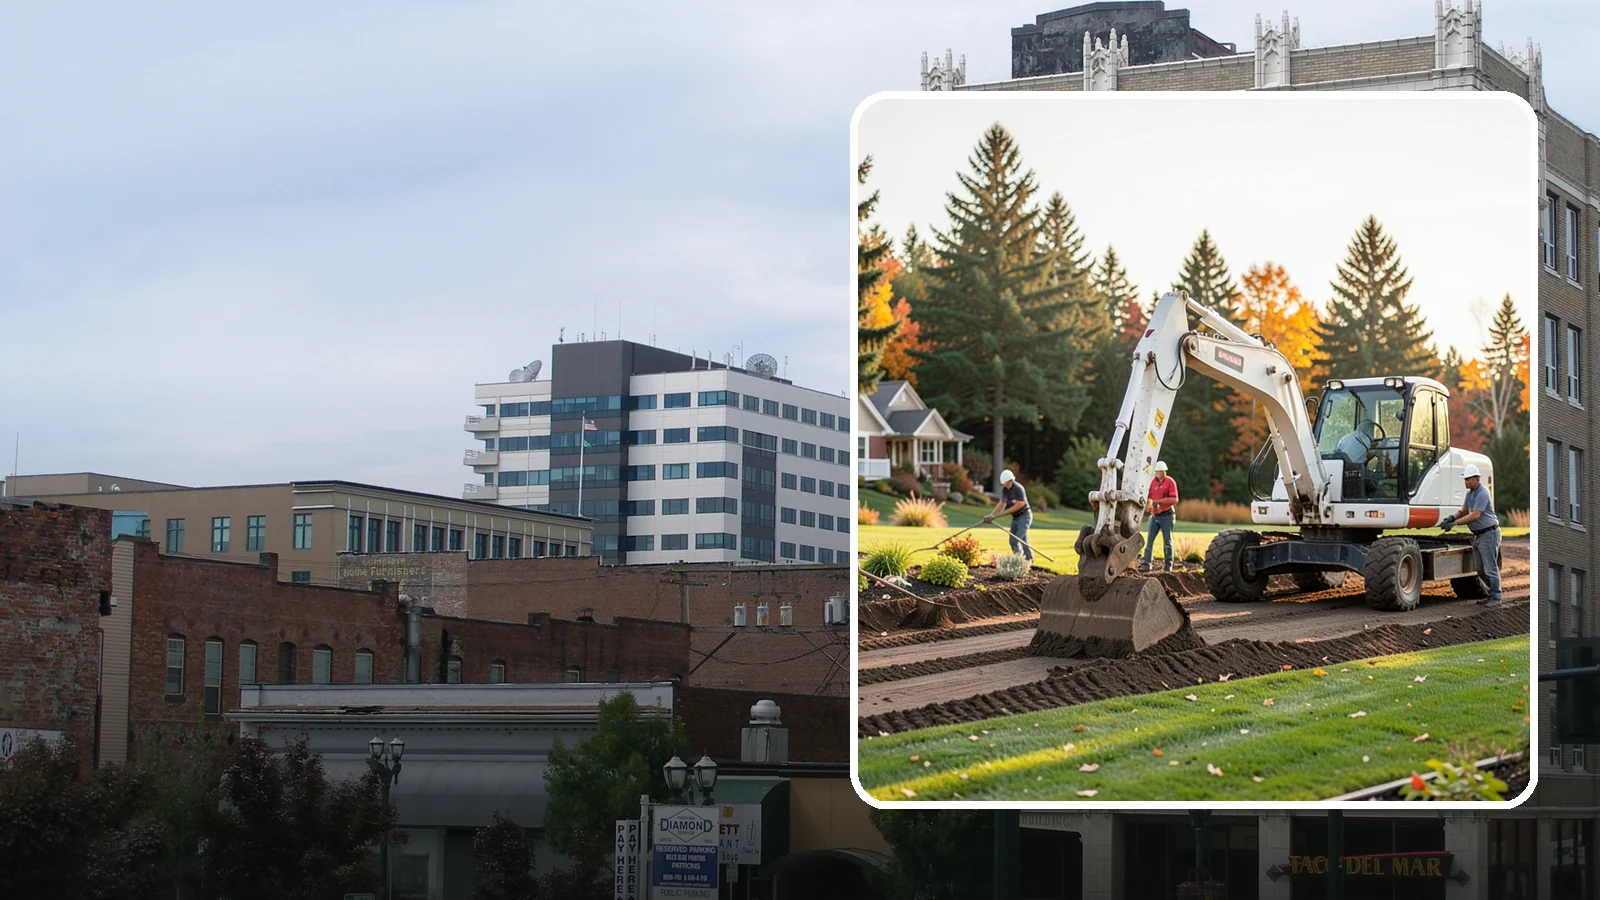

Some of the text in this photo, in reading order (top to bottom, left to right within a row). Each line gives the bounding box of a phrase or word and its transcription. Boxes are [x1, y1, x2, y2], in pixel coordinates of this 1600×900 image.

[370, 565, 427, 576] Furnishers
[660, 818, 713, 832] DIAMOND
[1022, 815, 1070, 828] BUILDING
[655, 845, 716, 854] RESERVED PARKING
[616, 825, 625, 893] PAY HERE
[627, 824, 636, 893] PAY HERE
[721, 851, 739, 862] Soup
[671, 862, 701, 870] PATRONS
[1289, 855, 1443, 877] TAC DEL MAR
[660, 888, 710, 898] PUBLIC PARKING
